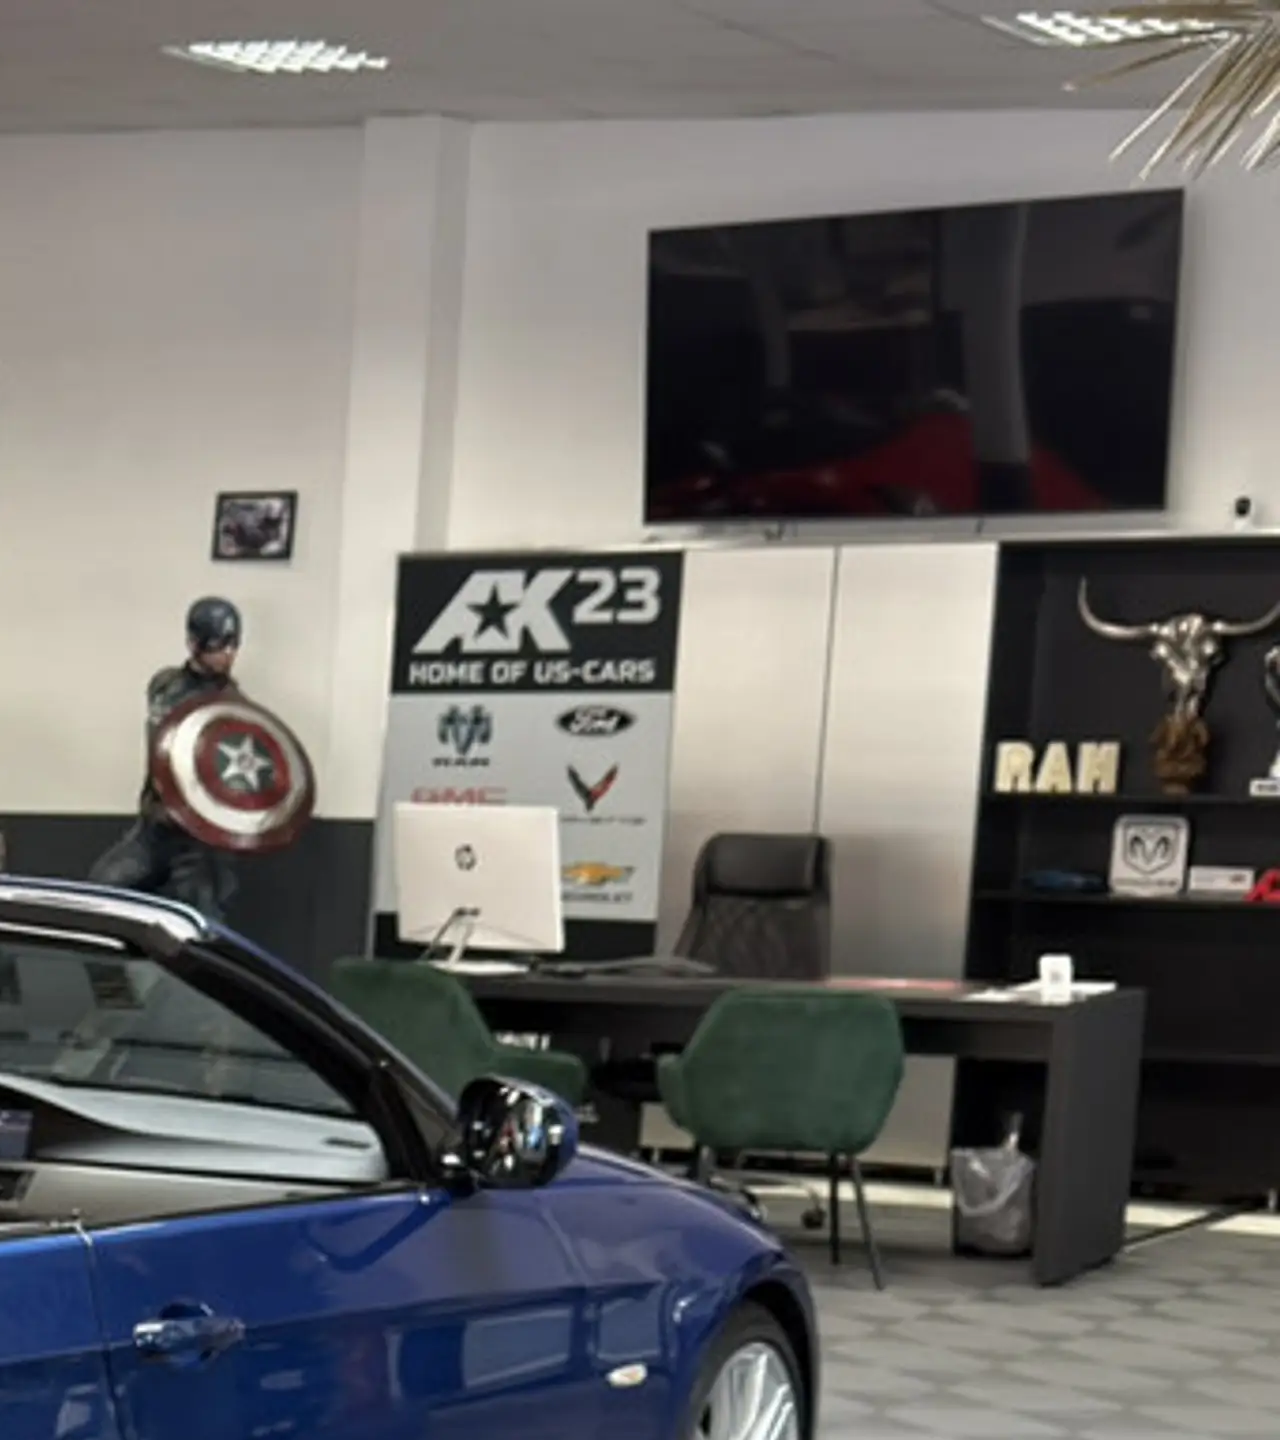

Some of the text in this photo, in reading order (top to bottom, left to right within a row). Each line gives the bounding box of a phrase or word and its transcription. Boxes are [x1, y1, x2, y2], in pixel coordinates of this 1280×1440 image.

[409, 659, 656, 684] HOME OF US-CARS
